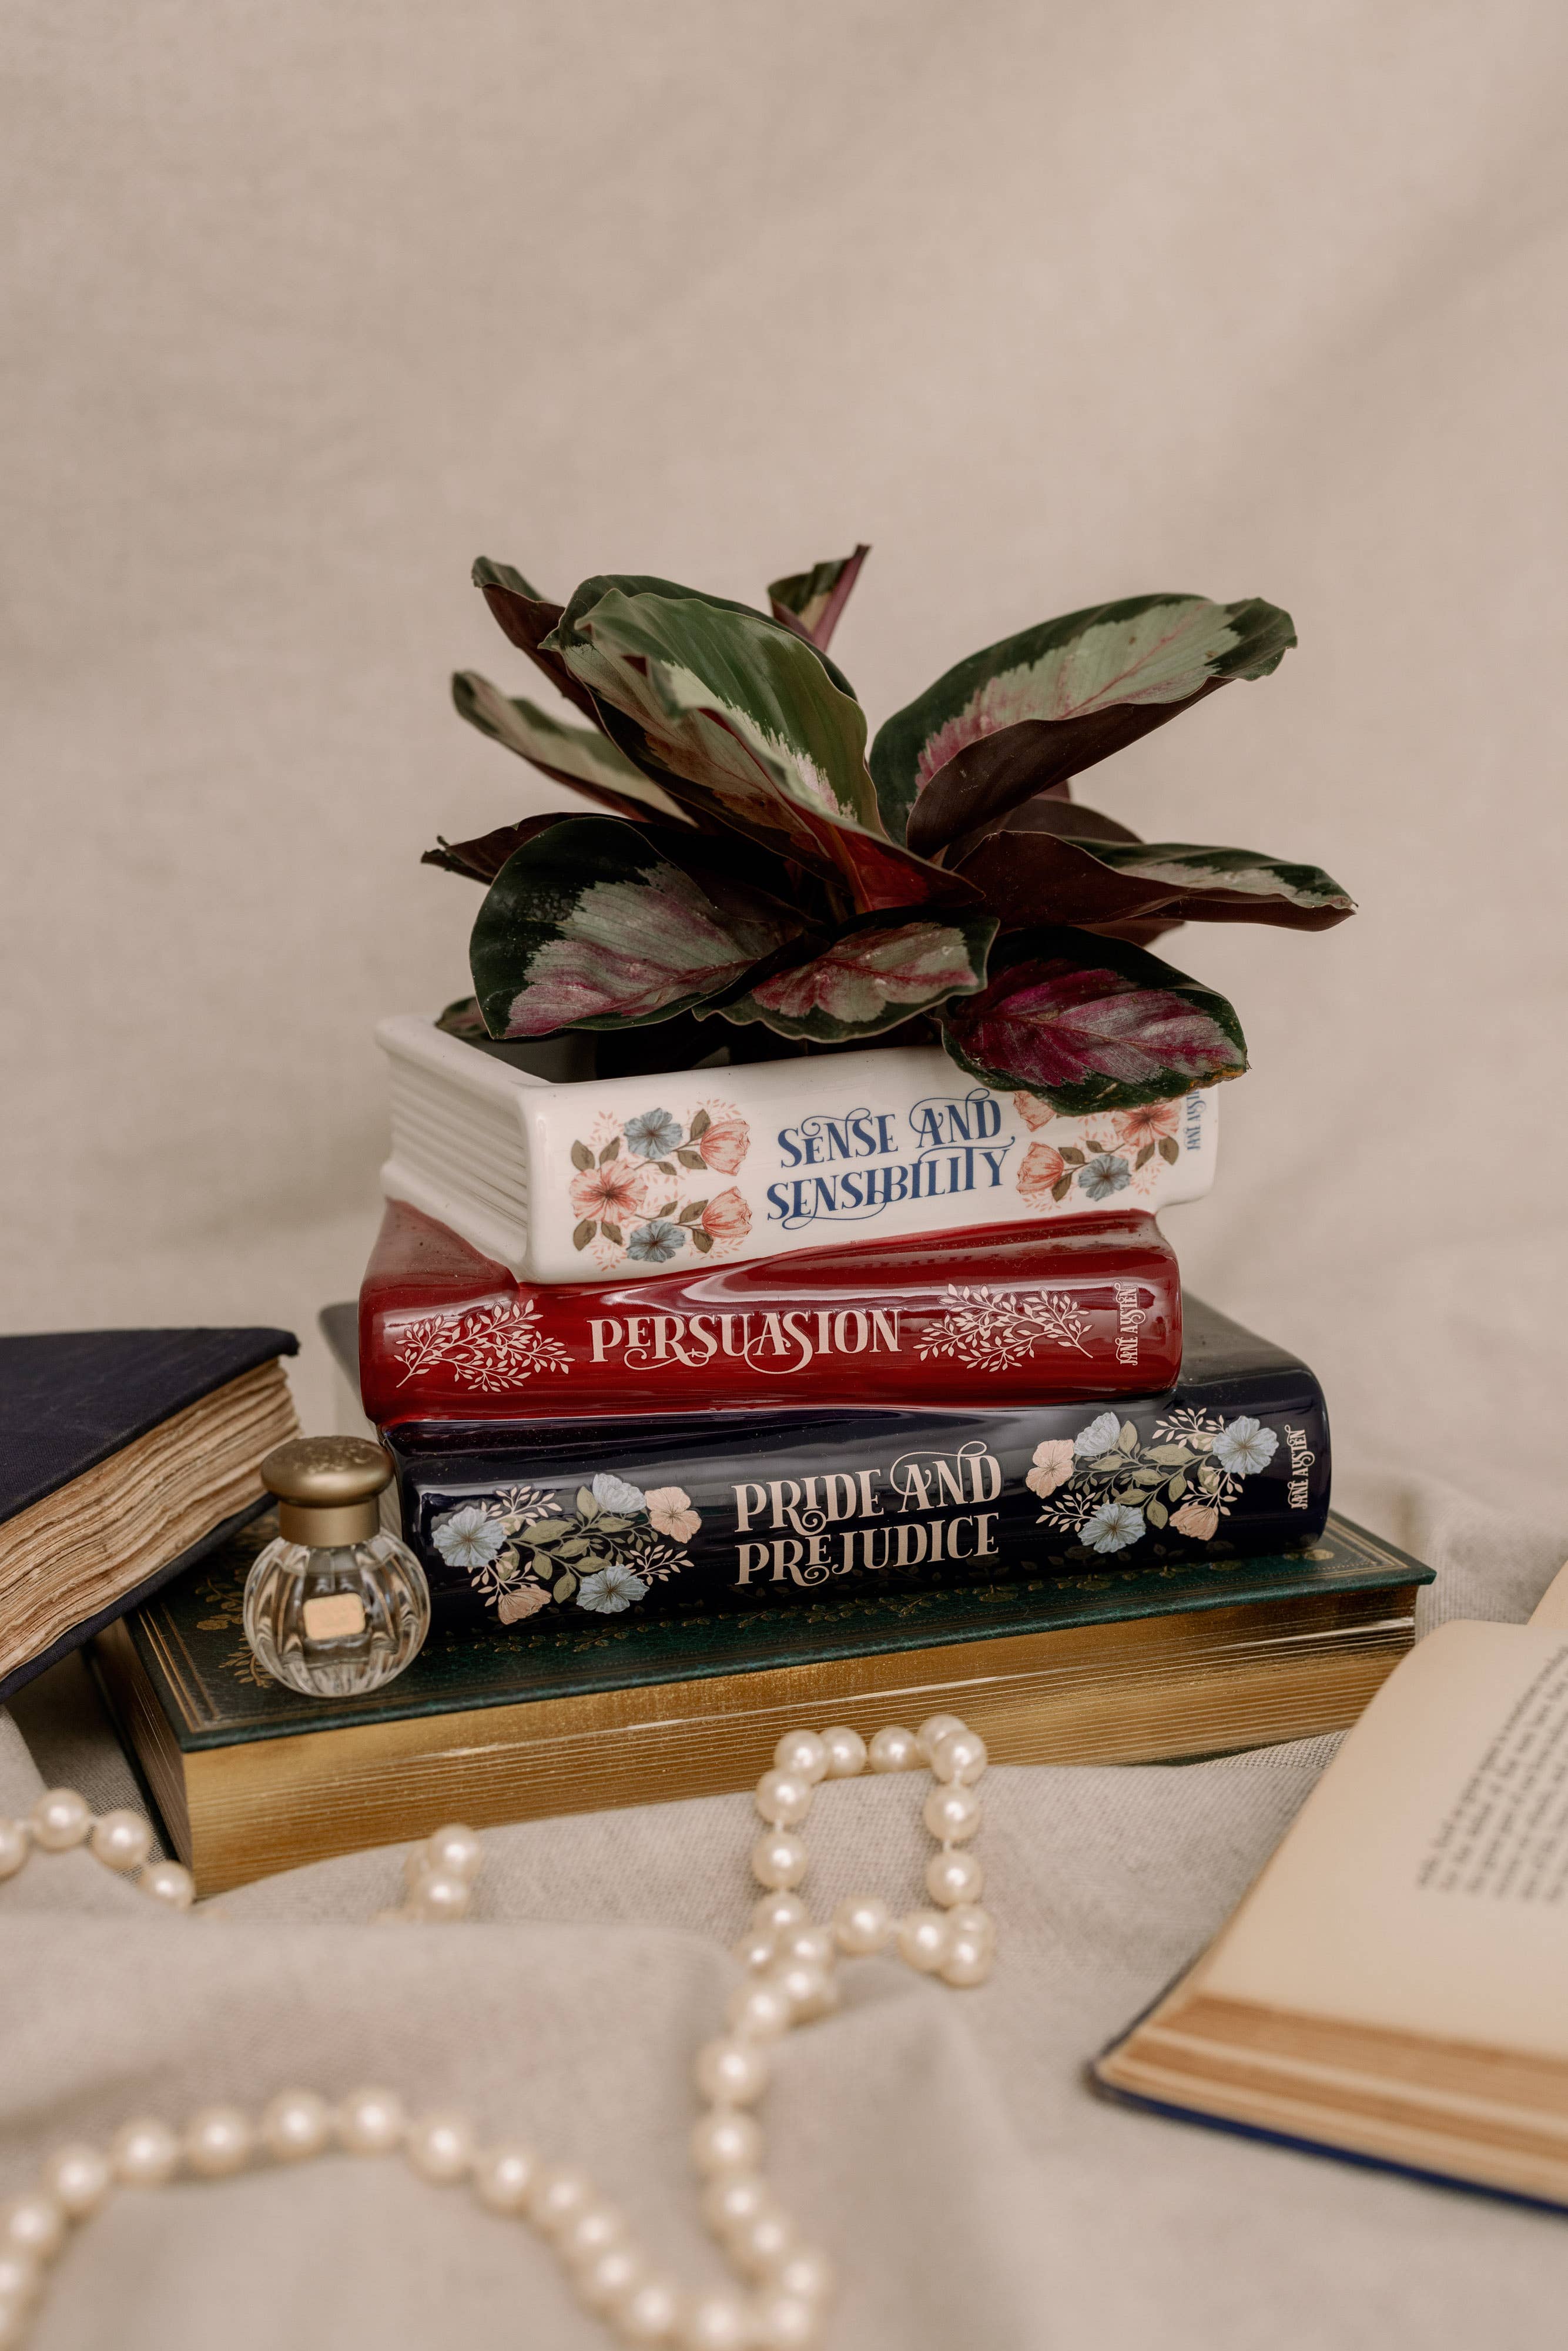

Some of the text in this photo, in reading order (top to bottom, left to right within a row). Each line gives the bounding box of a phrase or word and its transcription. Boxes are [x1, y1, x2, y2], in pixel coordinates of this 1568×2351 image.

[778, 1088, 1001, 1168] SENSE AND
[1184, 1124, 1201, 1151] JANE
[767, 1136, 1016, 1230] SENSIBILITY
[586, 1308, 902, 1374] PERSUASION
[1114, 1282, 1146, 1366] JANE AUSTEN
[731, 1441, 1001, 1536] PRIDE AND
[1284, 1425, 1315, 1510] JANE AUSTEN
[735, 1513, 1000, 1587] PREJUDICE
